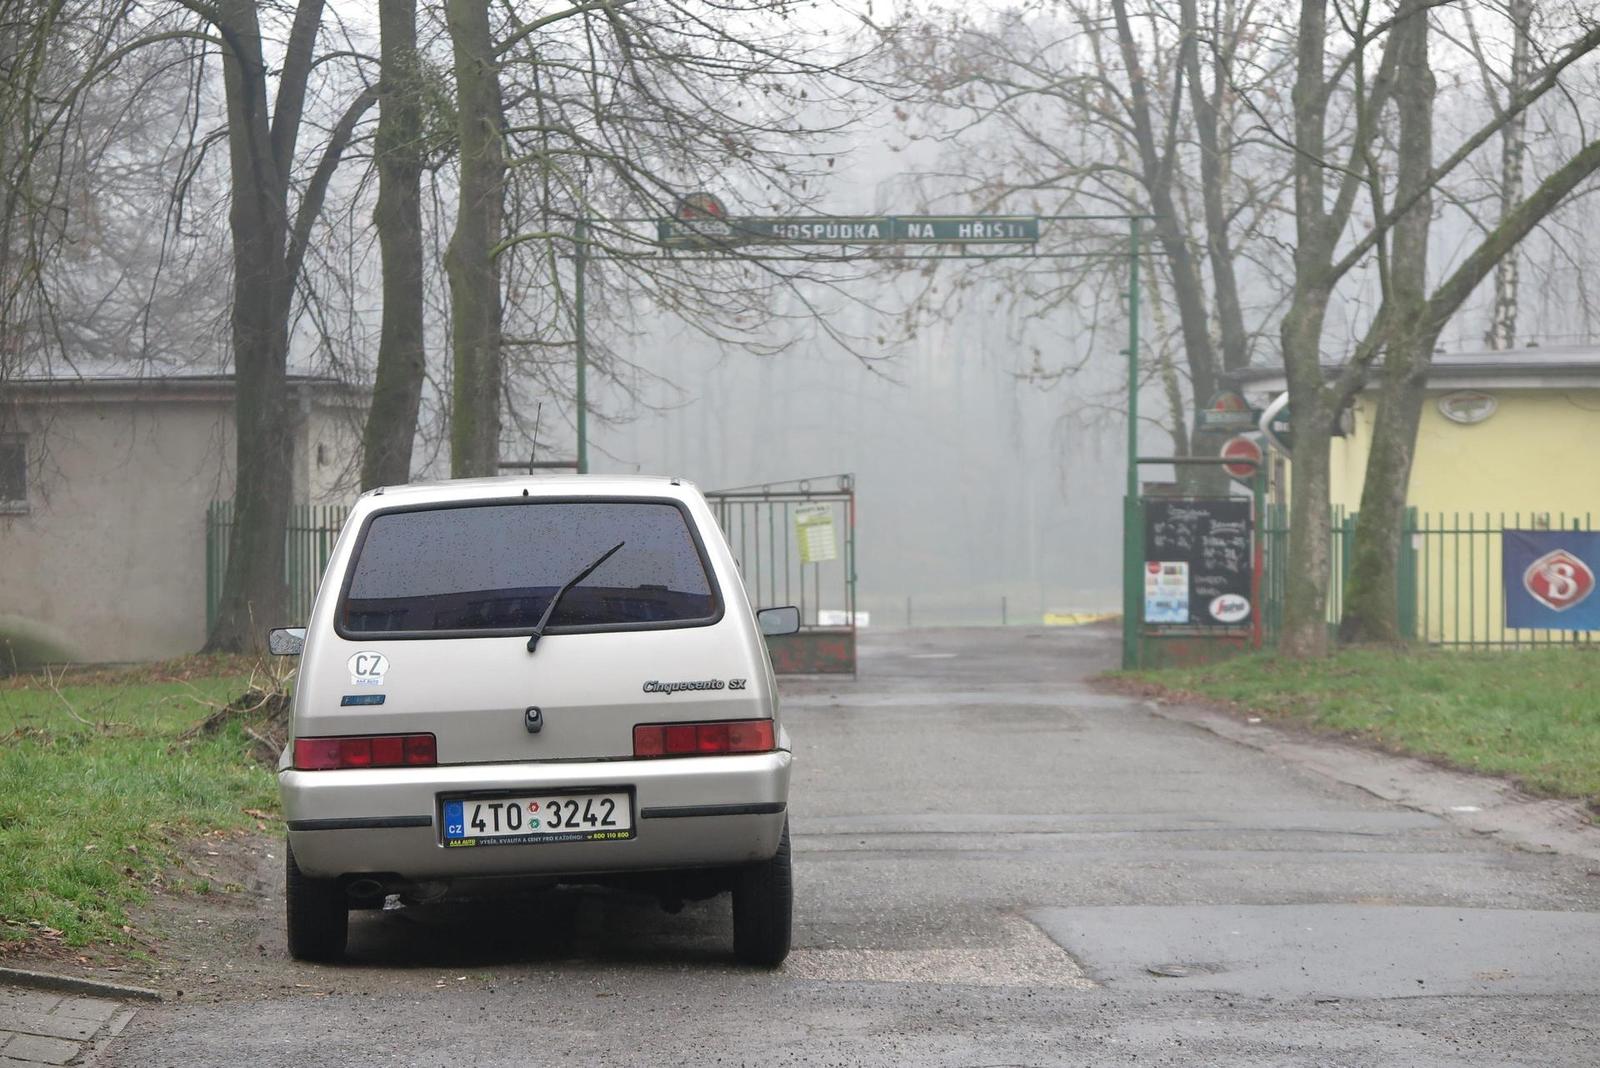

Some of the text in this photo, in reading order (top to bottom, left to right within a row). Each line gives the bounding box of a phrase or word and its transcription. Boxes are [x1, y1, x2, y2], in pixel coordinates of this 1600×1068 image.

[908, 223, 935, 238] NA
[356, 655, 381, 676] CZ
[643, 680, 725, 695] Cinquecento
[546, 798, 616, 828] 3242
[448, 825, 462, 834] CZ
